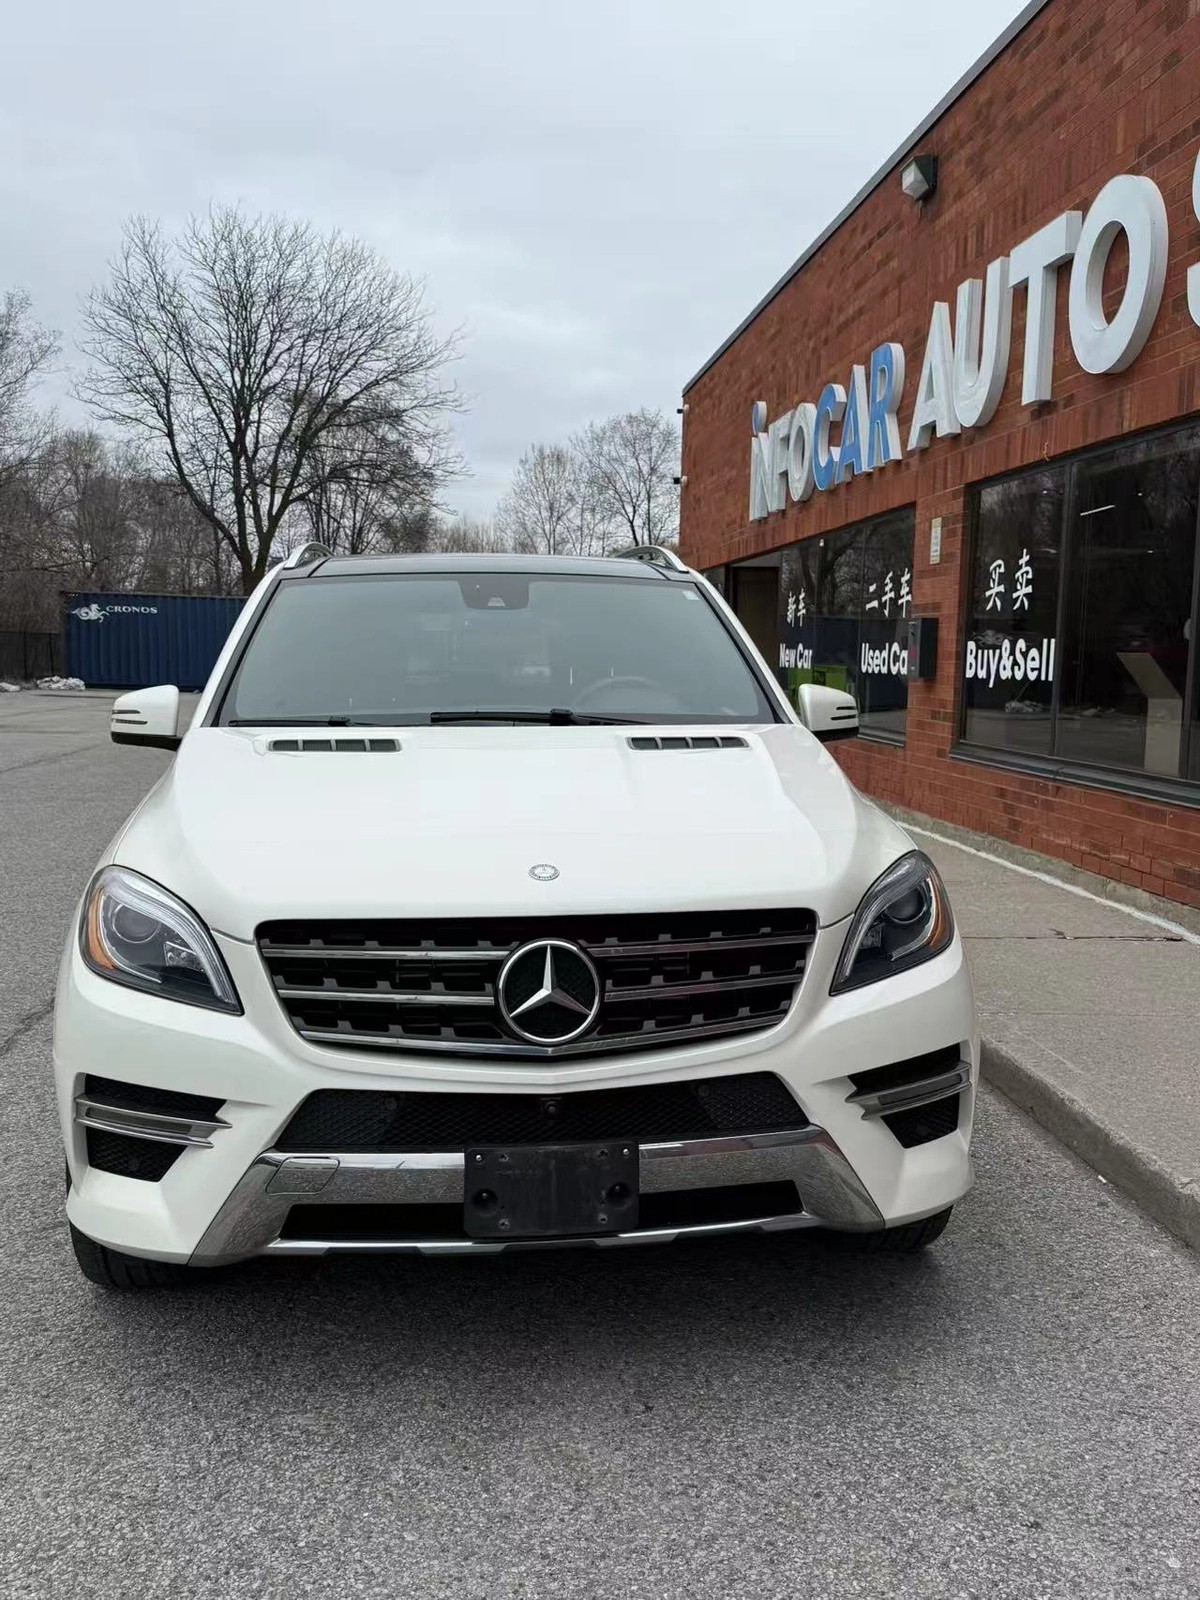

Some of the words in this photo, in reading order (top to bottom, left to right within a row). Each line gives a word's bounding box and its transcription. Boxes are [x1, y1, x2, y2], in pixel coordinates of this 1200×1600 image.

[907, 174, 1169, 452] AUTO
[865, 567, 912, 618] 二手车
[985, 548, 1033, 612] 买卖
[105, 604, 158, 614] CRONOS
[786, 587, 807, 628] 新车
[779, 642, 797, 668] New
[796, 642, 813, 669] Car
[861, 642, 889, 675] Used
[889, 641, 909, 676] Ca
[965, 638, 1056, 688] Buy&Sell
